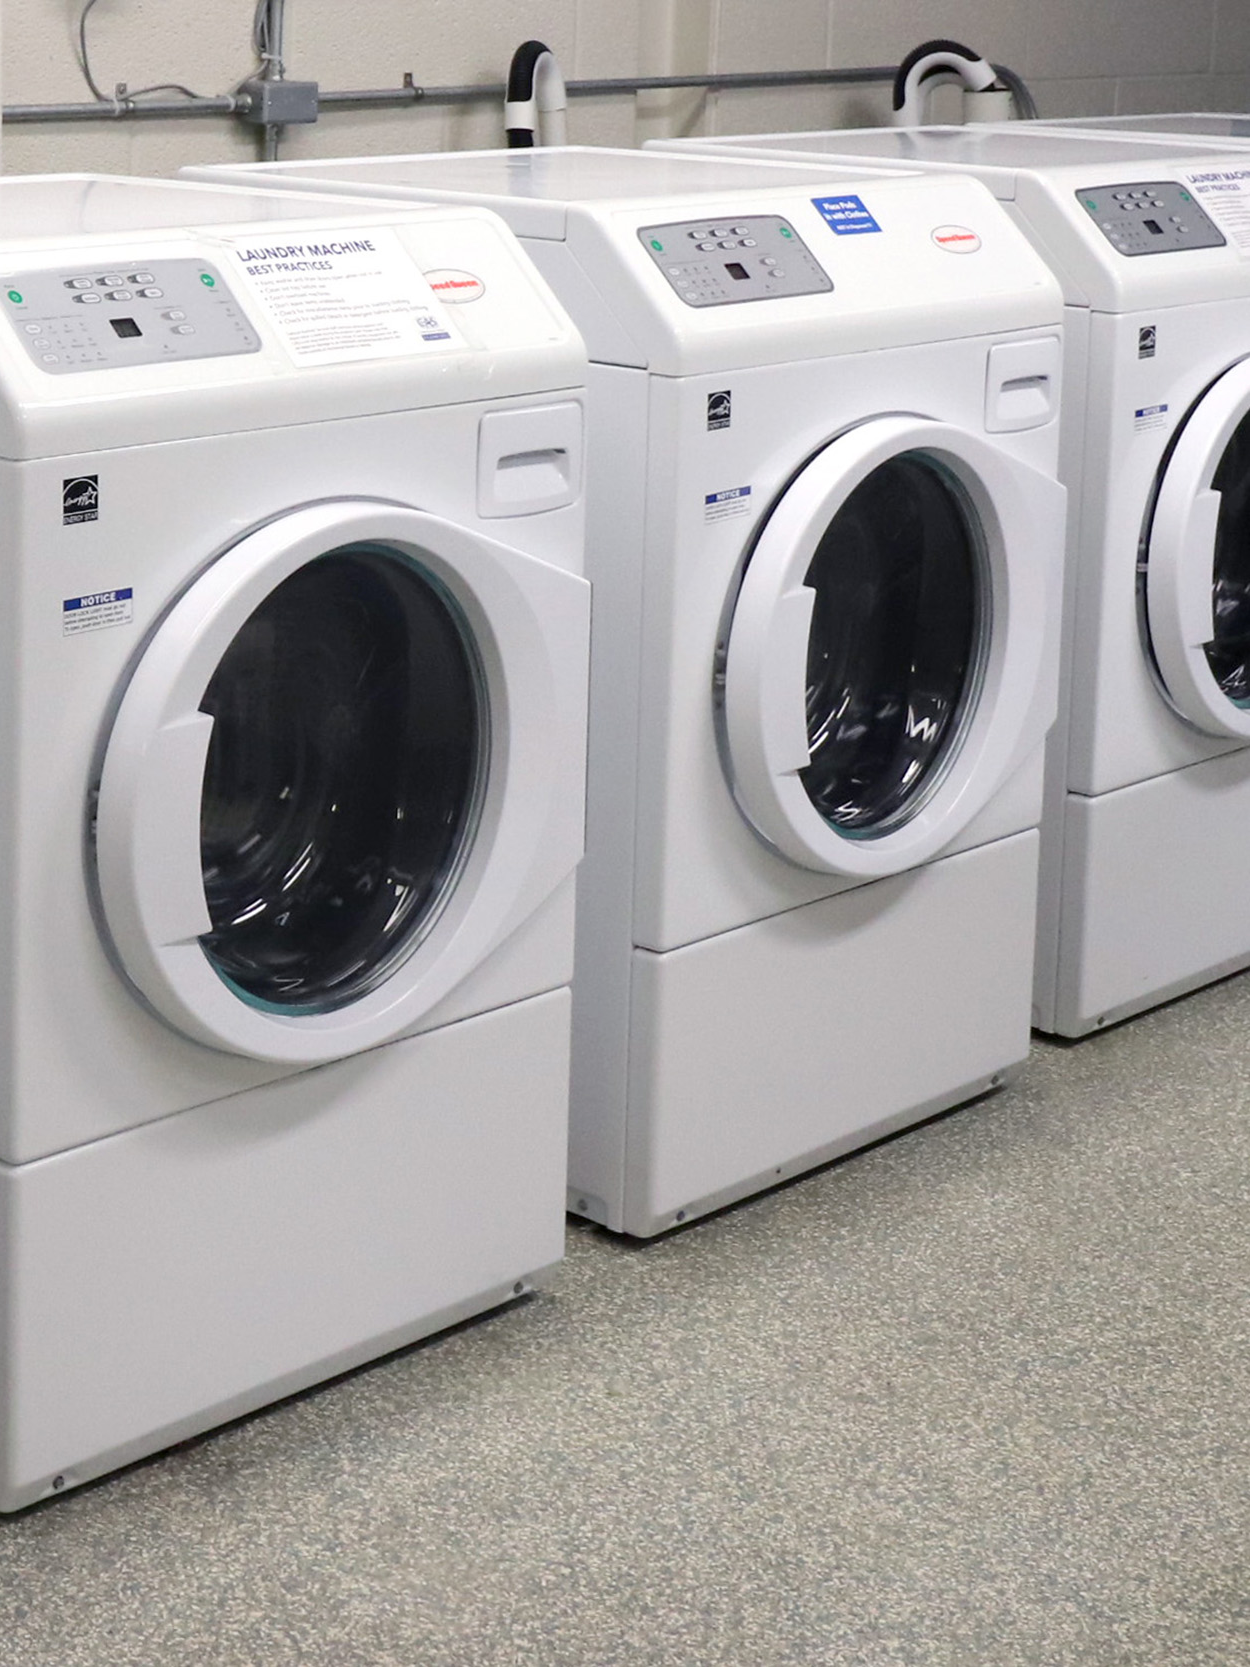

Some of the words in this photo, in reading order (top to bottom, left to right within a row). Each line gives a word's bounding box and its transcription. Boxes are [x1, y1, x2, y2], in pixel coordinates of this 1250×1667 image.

[236, 245, 306, 262] LAUNDRY
[306, 240, 376, 257] MACHINE
[246, 264, 274, 276] BEST
[275, 260, 333, 272] PRACTICES
[80, 591, 116, 608] NOTICE
